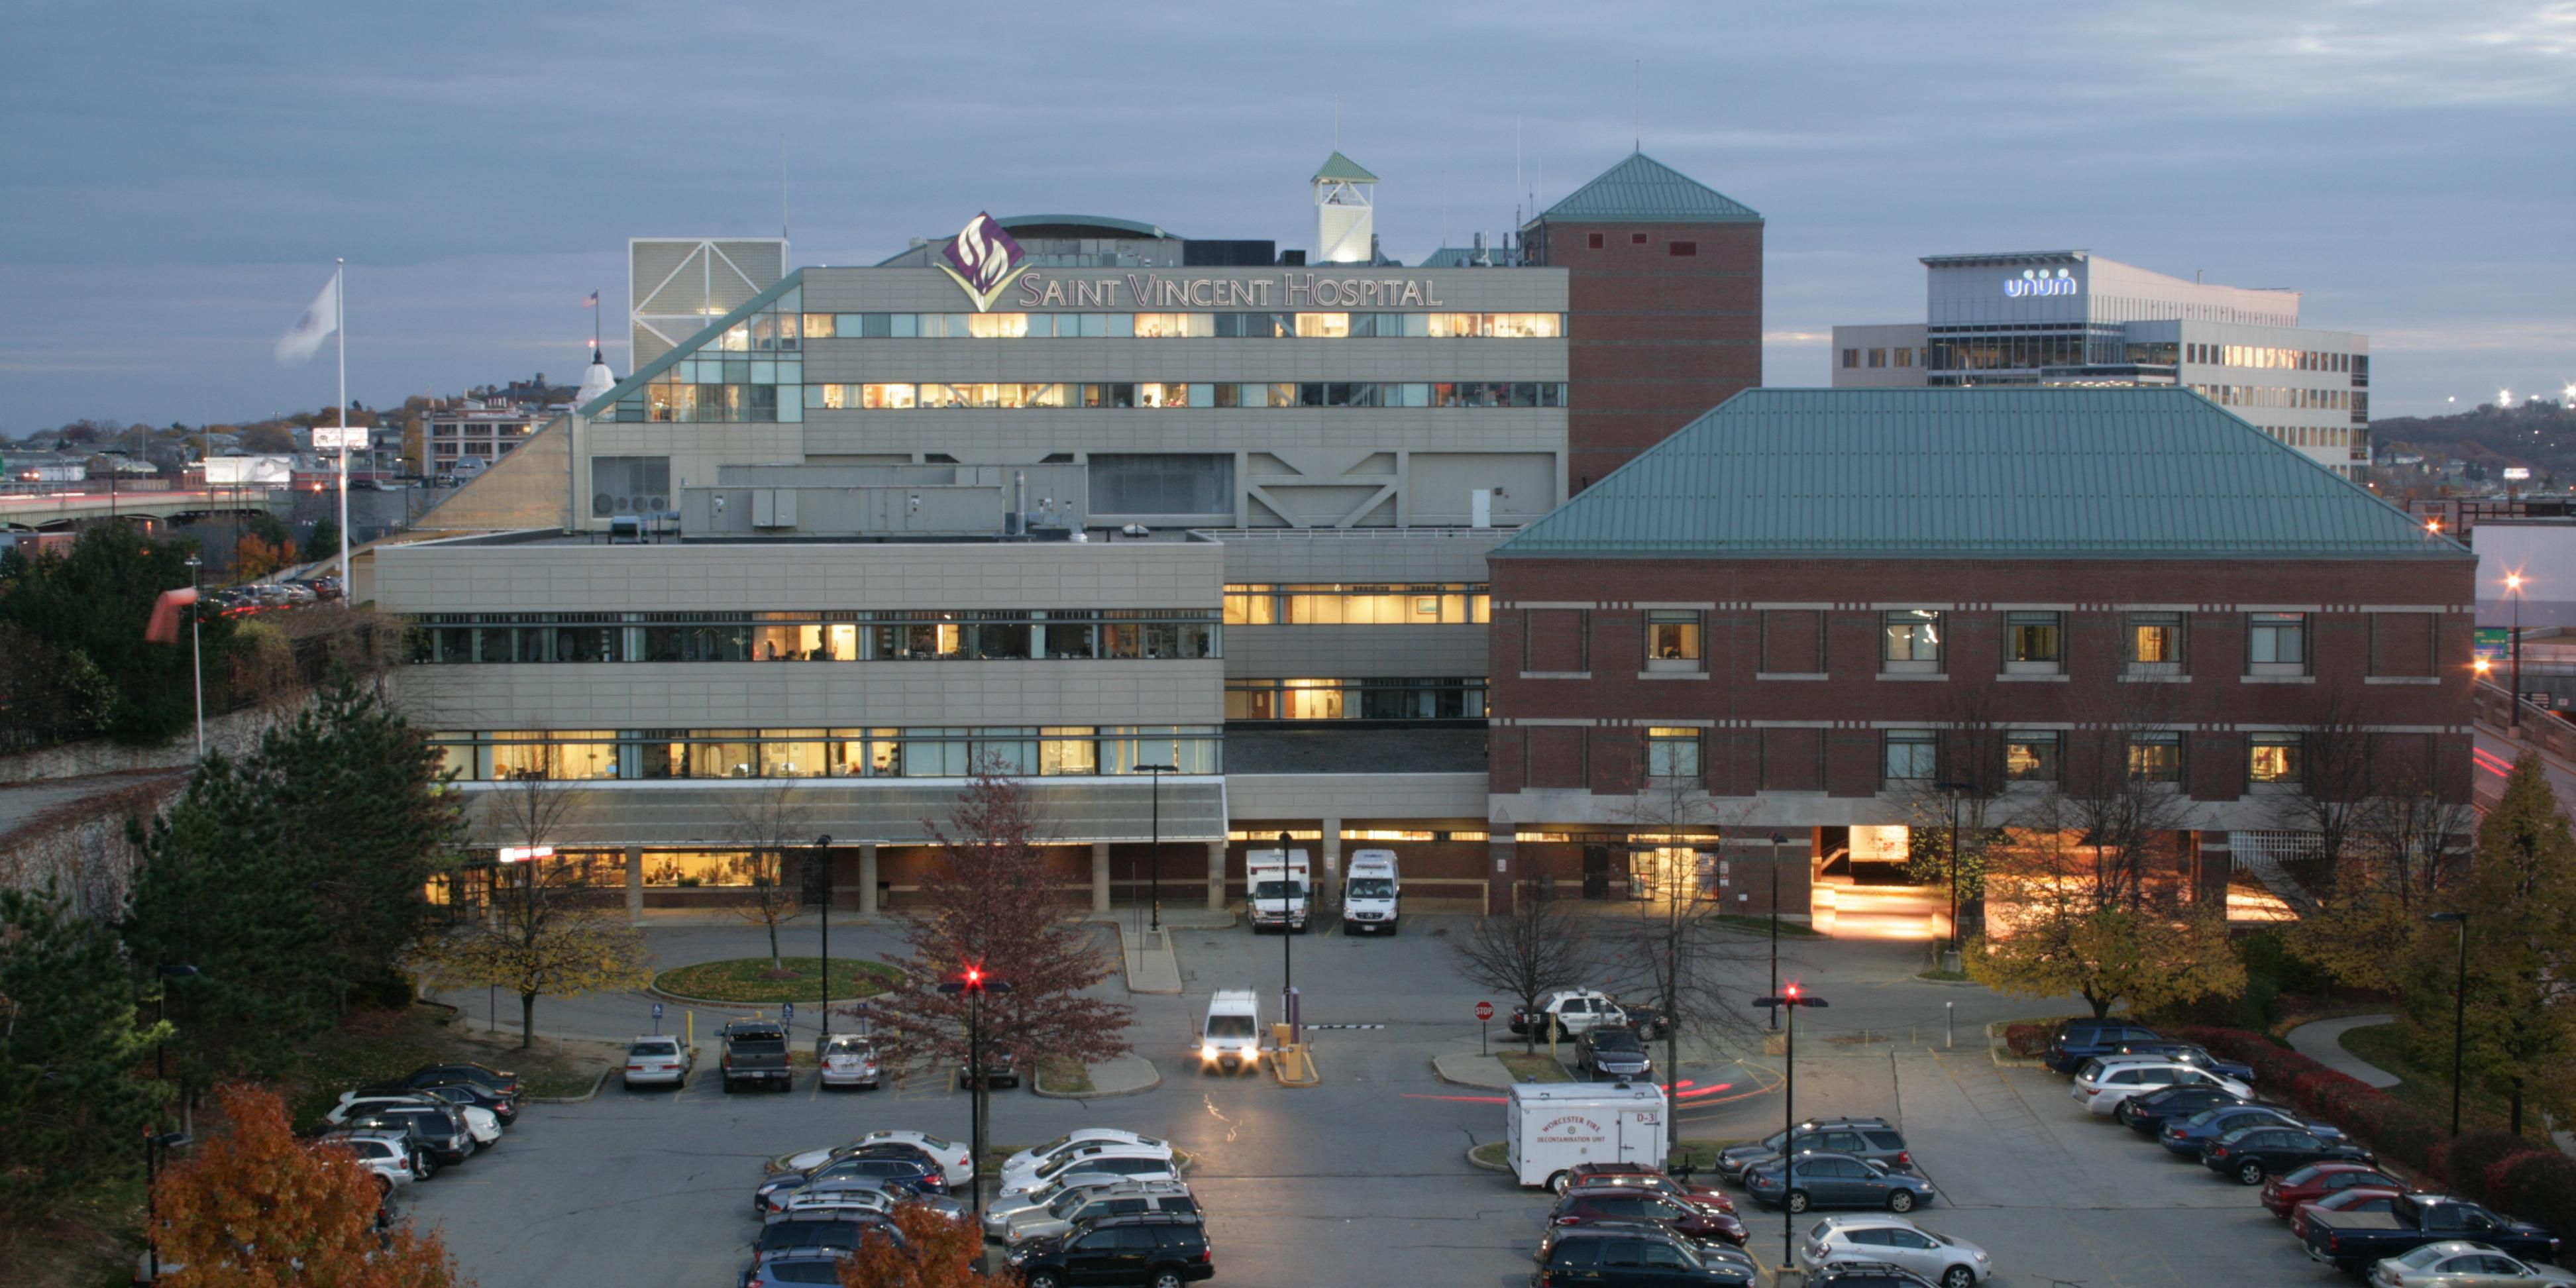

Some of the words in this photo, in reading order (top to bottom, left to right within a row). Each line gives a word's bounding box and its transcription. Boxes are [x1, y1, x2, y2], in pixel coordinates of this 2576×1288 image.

[1019, 272, 1121, 308] SAINT
[1127, 273, 1273, 307] VINCENT
[1285, 273, 1443, 307] HOSPITAL
[2004, 268, 2076, 297] unum
[1476, 1006, 1493, 1015] STOP
[1542, 1116, 1584, 1132] WORCESTER
[1586, 1120, 1601, 1133] FIRE
